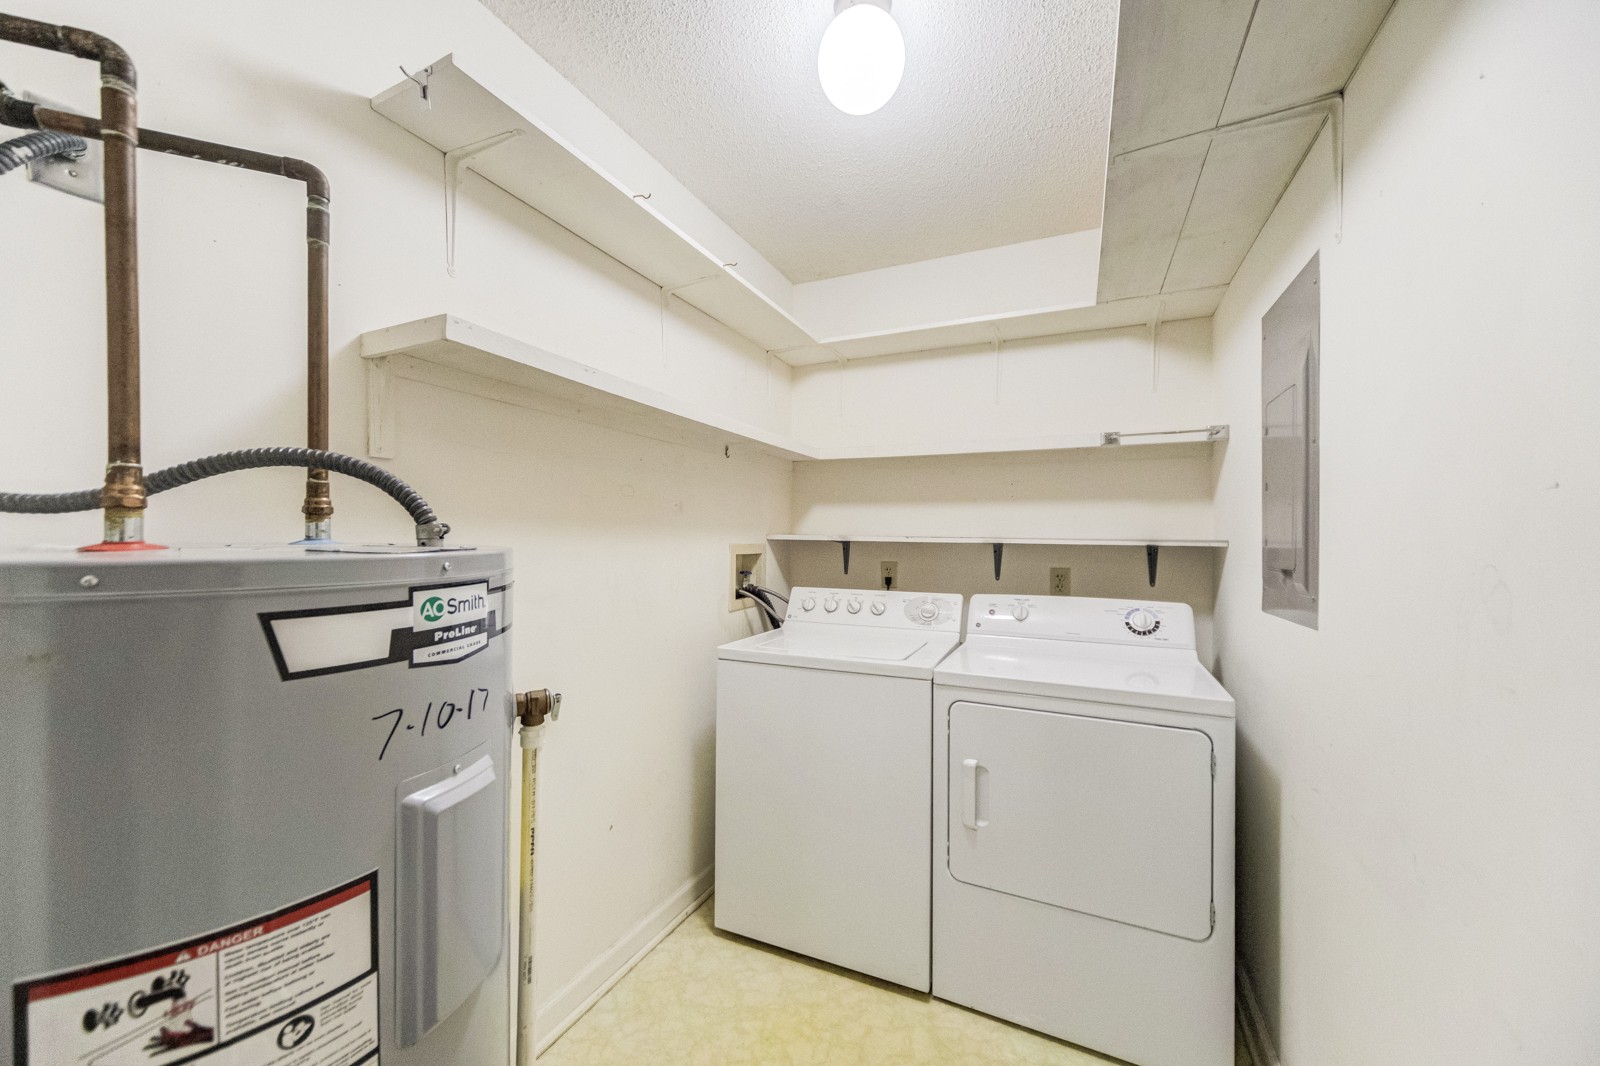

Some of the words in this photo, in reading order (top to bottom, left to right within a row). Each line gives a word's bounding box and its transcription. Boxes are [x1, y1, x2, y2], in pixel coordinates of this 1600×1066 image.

[447, 594, 486, 614] Smith
[434, 625, 477, 641] ProLine
[428, 645, 465, 658] COMMERCIAL
[372, 688, 489, 761] 7-10-17
[196, 926, 264, 956] DANGER
